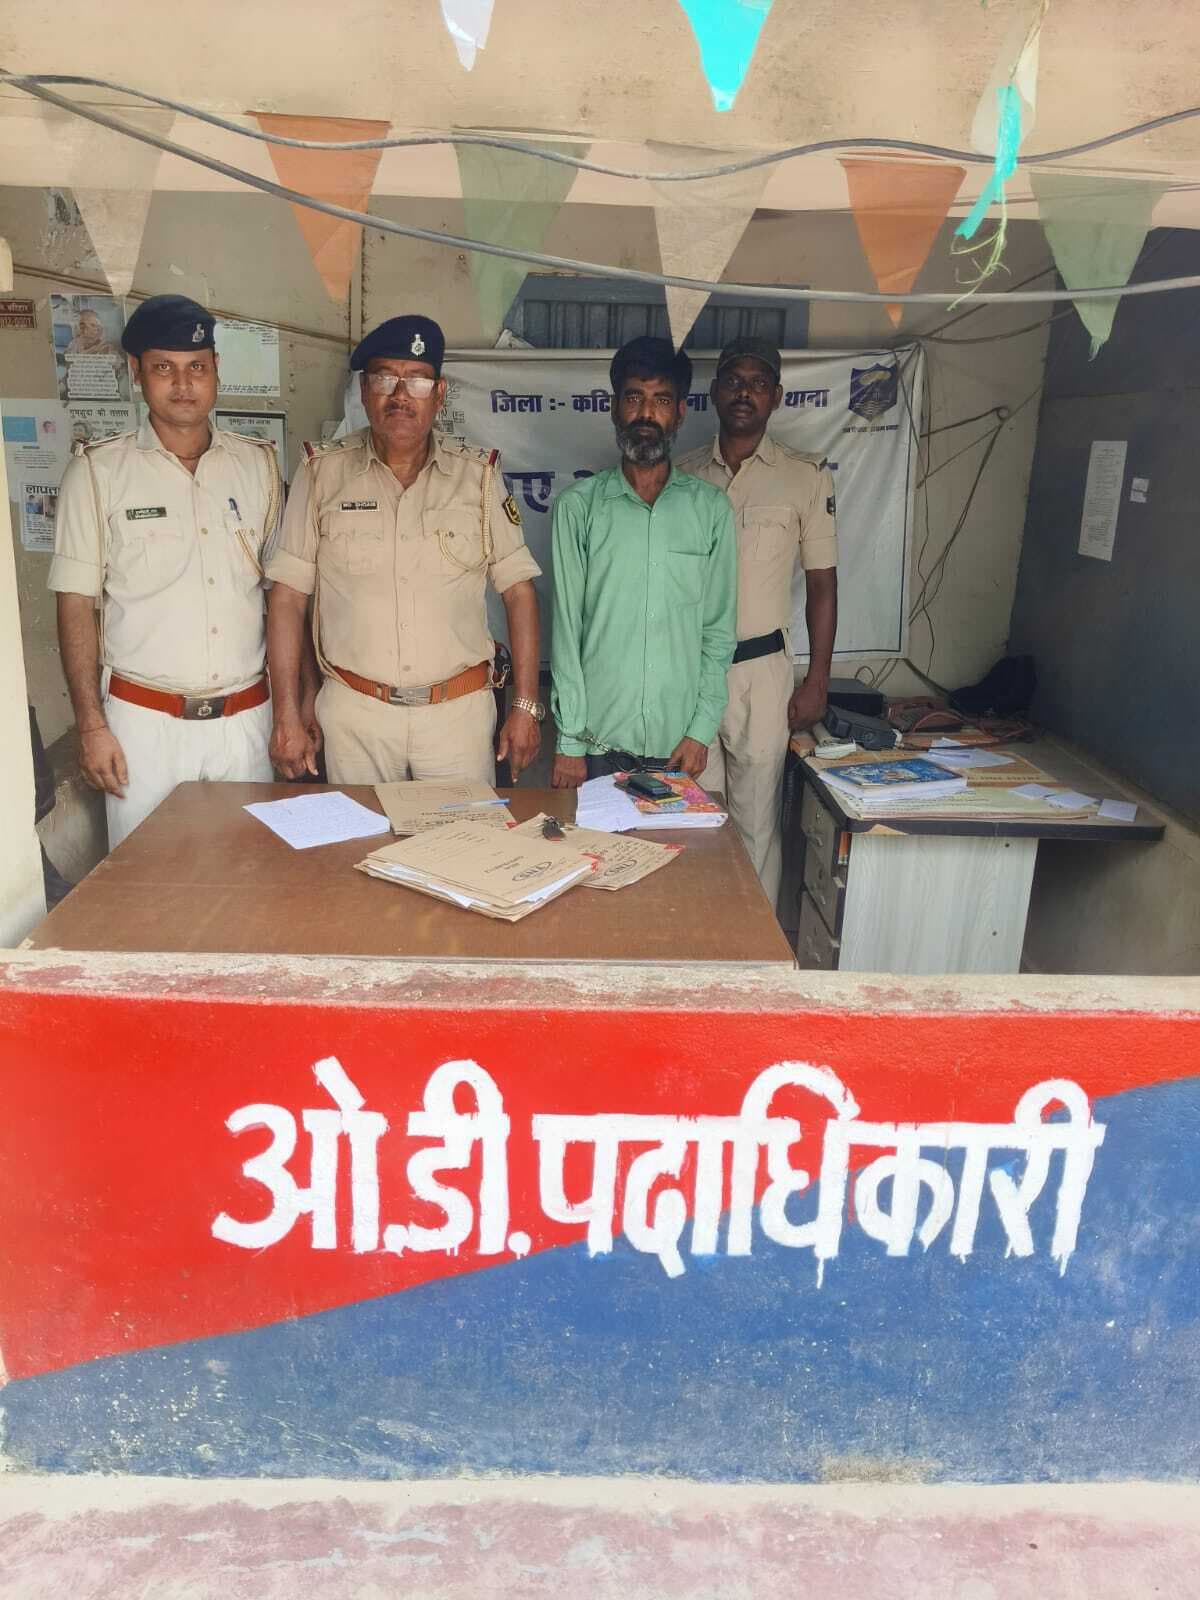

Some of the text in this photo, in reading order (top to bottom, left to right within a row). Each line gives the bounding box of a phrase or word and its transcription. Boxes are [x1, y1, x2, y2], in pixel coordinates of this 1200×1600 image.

[490, 389, 543, 413] जिला
[571, 389, 612, 413] कटि
[784, 389, 831, 409] थाना
